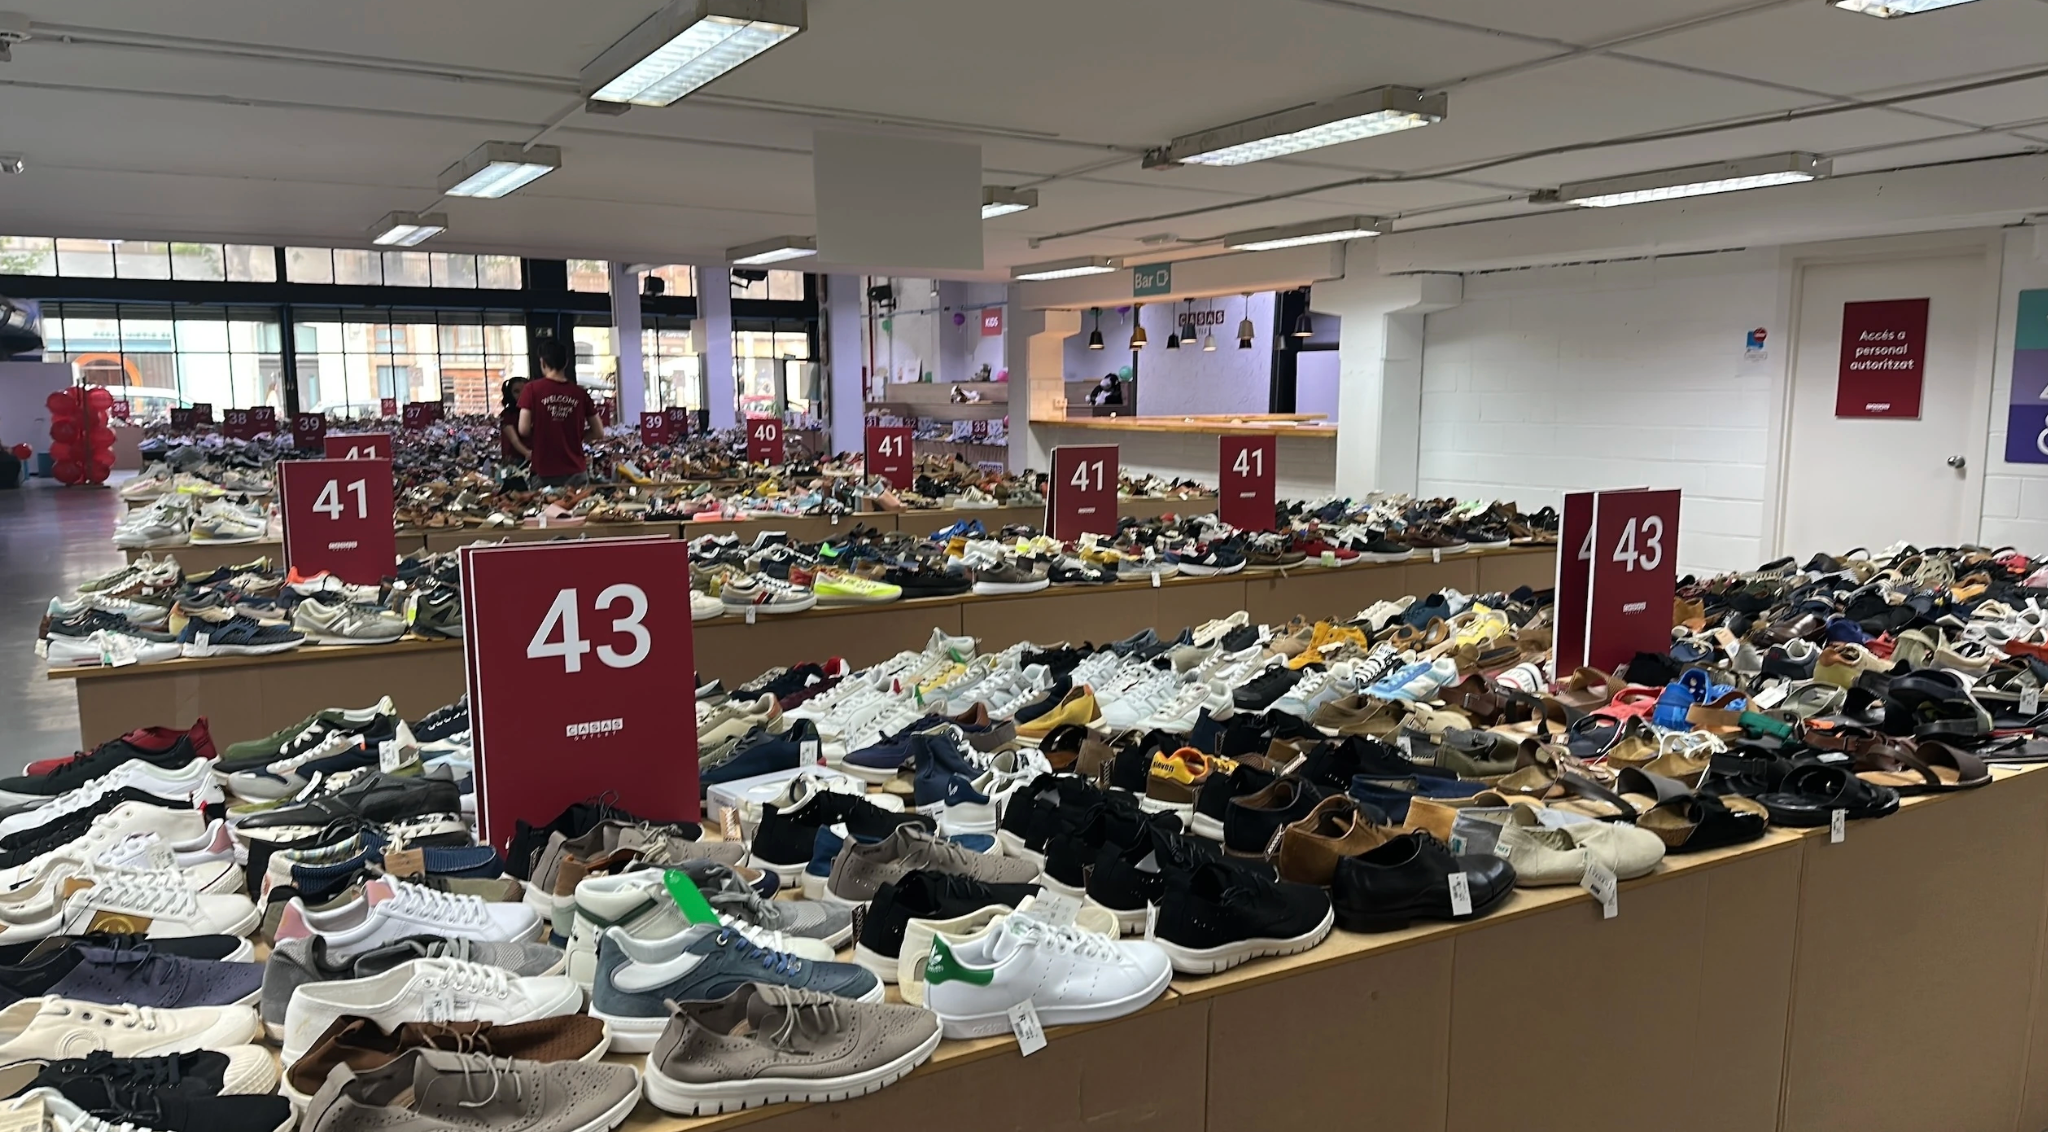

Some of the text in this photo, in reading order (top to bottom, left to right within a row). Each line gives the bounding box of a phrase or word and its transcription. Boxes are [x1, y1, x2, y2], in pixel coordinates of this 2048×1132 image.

[1134, 273, 1154, 289] Bar
[1179, 311, 1224, 326] CASAS
[1859, 328, 1906, 341] Accés a
[1855, 343, 1908, 359] personal
[1849, 358, 1914, 371] autoritzat
[541, 394, 580, 408] WELCOME
[228, 412, 247, 425] 38
[255, 409, 271, 420] 37
[406, 407, 421, 418] 37
[669, 409, 684, 421] 38
[299, 416, 320, 431] 39
[645, 415, 663, 429] 39
[974, 421, 986, 433] 33
[754, 424, 777, 442] 40
[878, 435, 903, 457] 41
[1232, 448, 1263, 478] 41
[1070, 460, 1104, 492] 41
[312, 478, 368, 520] 41
[1612, 515, 1663, 572] 43
[526, 583, 651, 673] 43
[566, 718, 623, 737] CASAS
